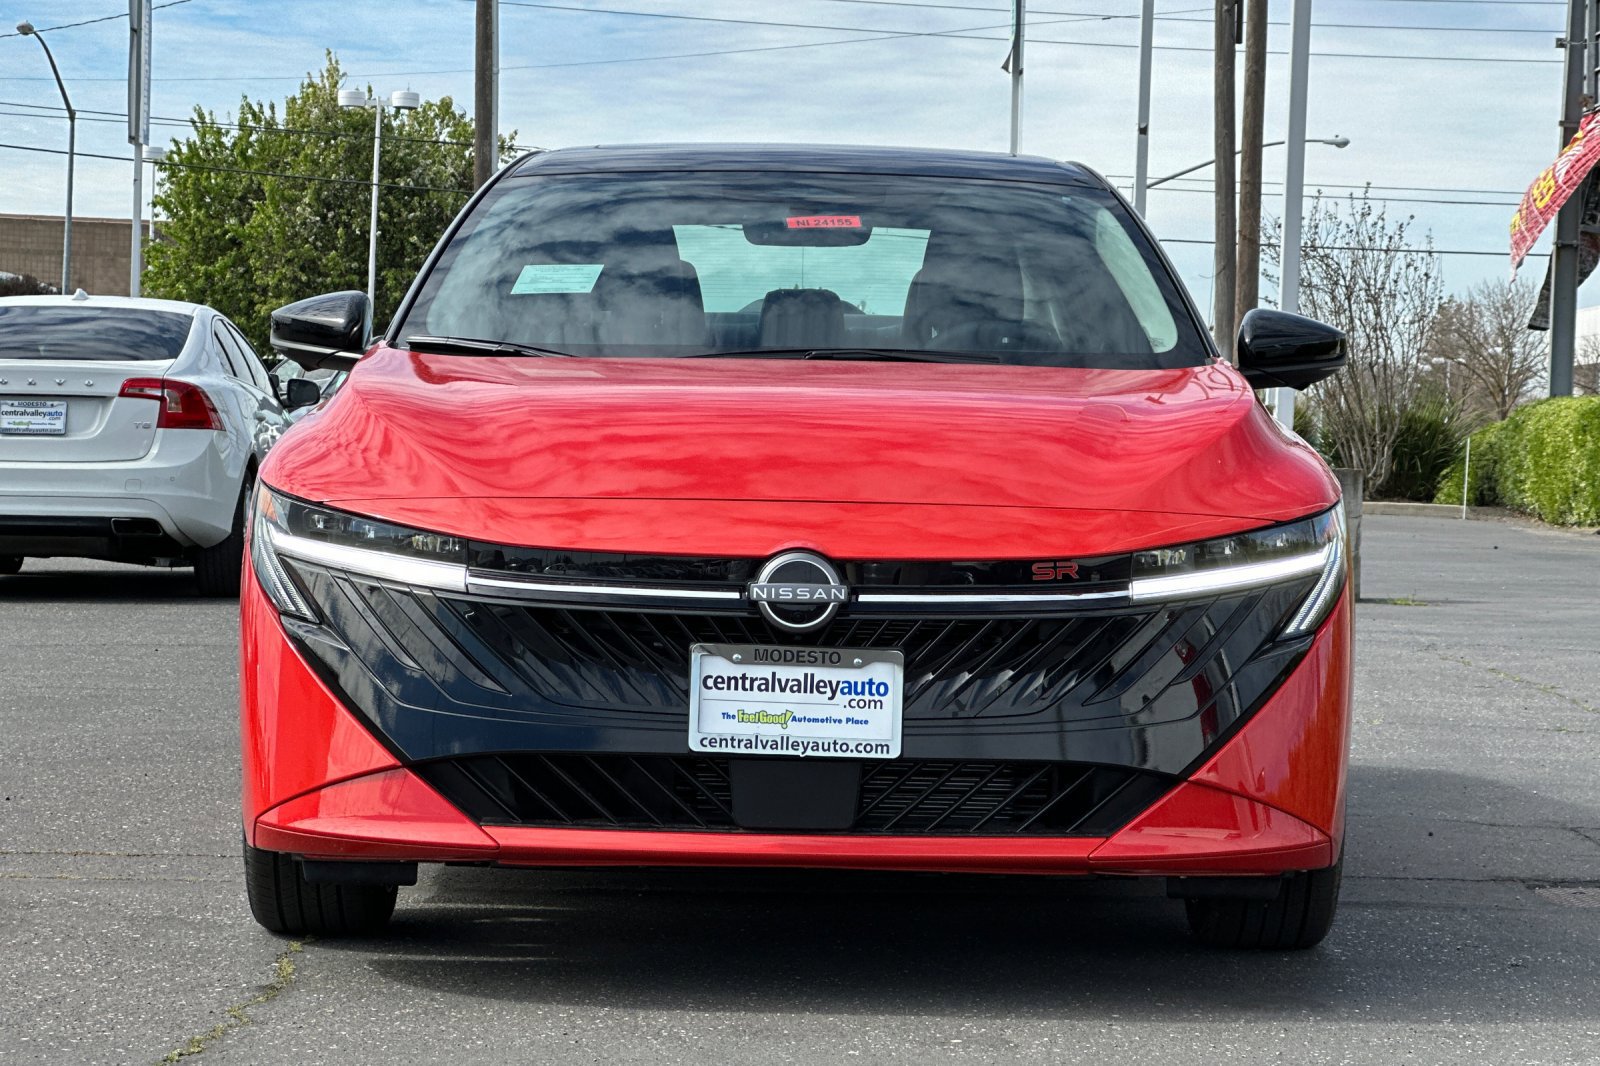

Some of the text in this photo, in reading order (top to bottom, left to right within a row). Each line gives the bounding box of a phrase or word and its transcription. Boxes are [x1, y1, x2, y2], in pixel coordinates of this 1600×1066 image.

[814, 218, 853, 226] 24155
[1031, 561, 1080, 581] SR
[753, 587, 845, 600] NISSAN
[754, 648, 842, 665] MODESTO
[702, 671, 890, 701] centralvalleyauto
[843, 697, 883, 710] .com
[721, 712, 736, 720] The
[791, 714, 843, 725] Automotive
[845, 716, 869, 725] Place
[699, 734, 890, 756] centralvalleyauto.com
